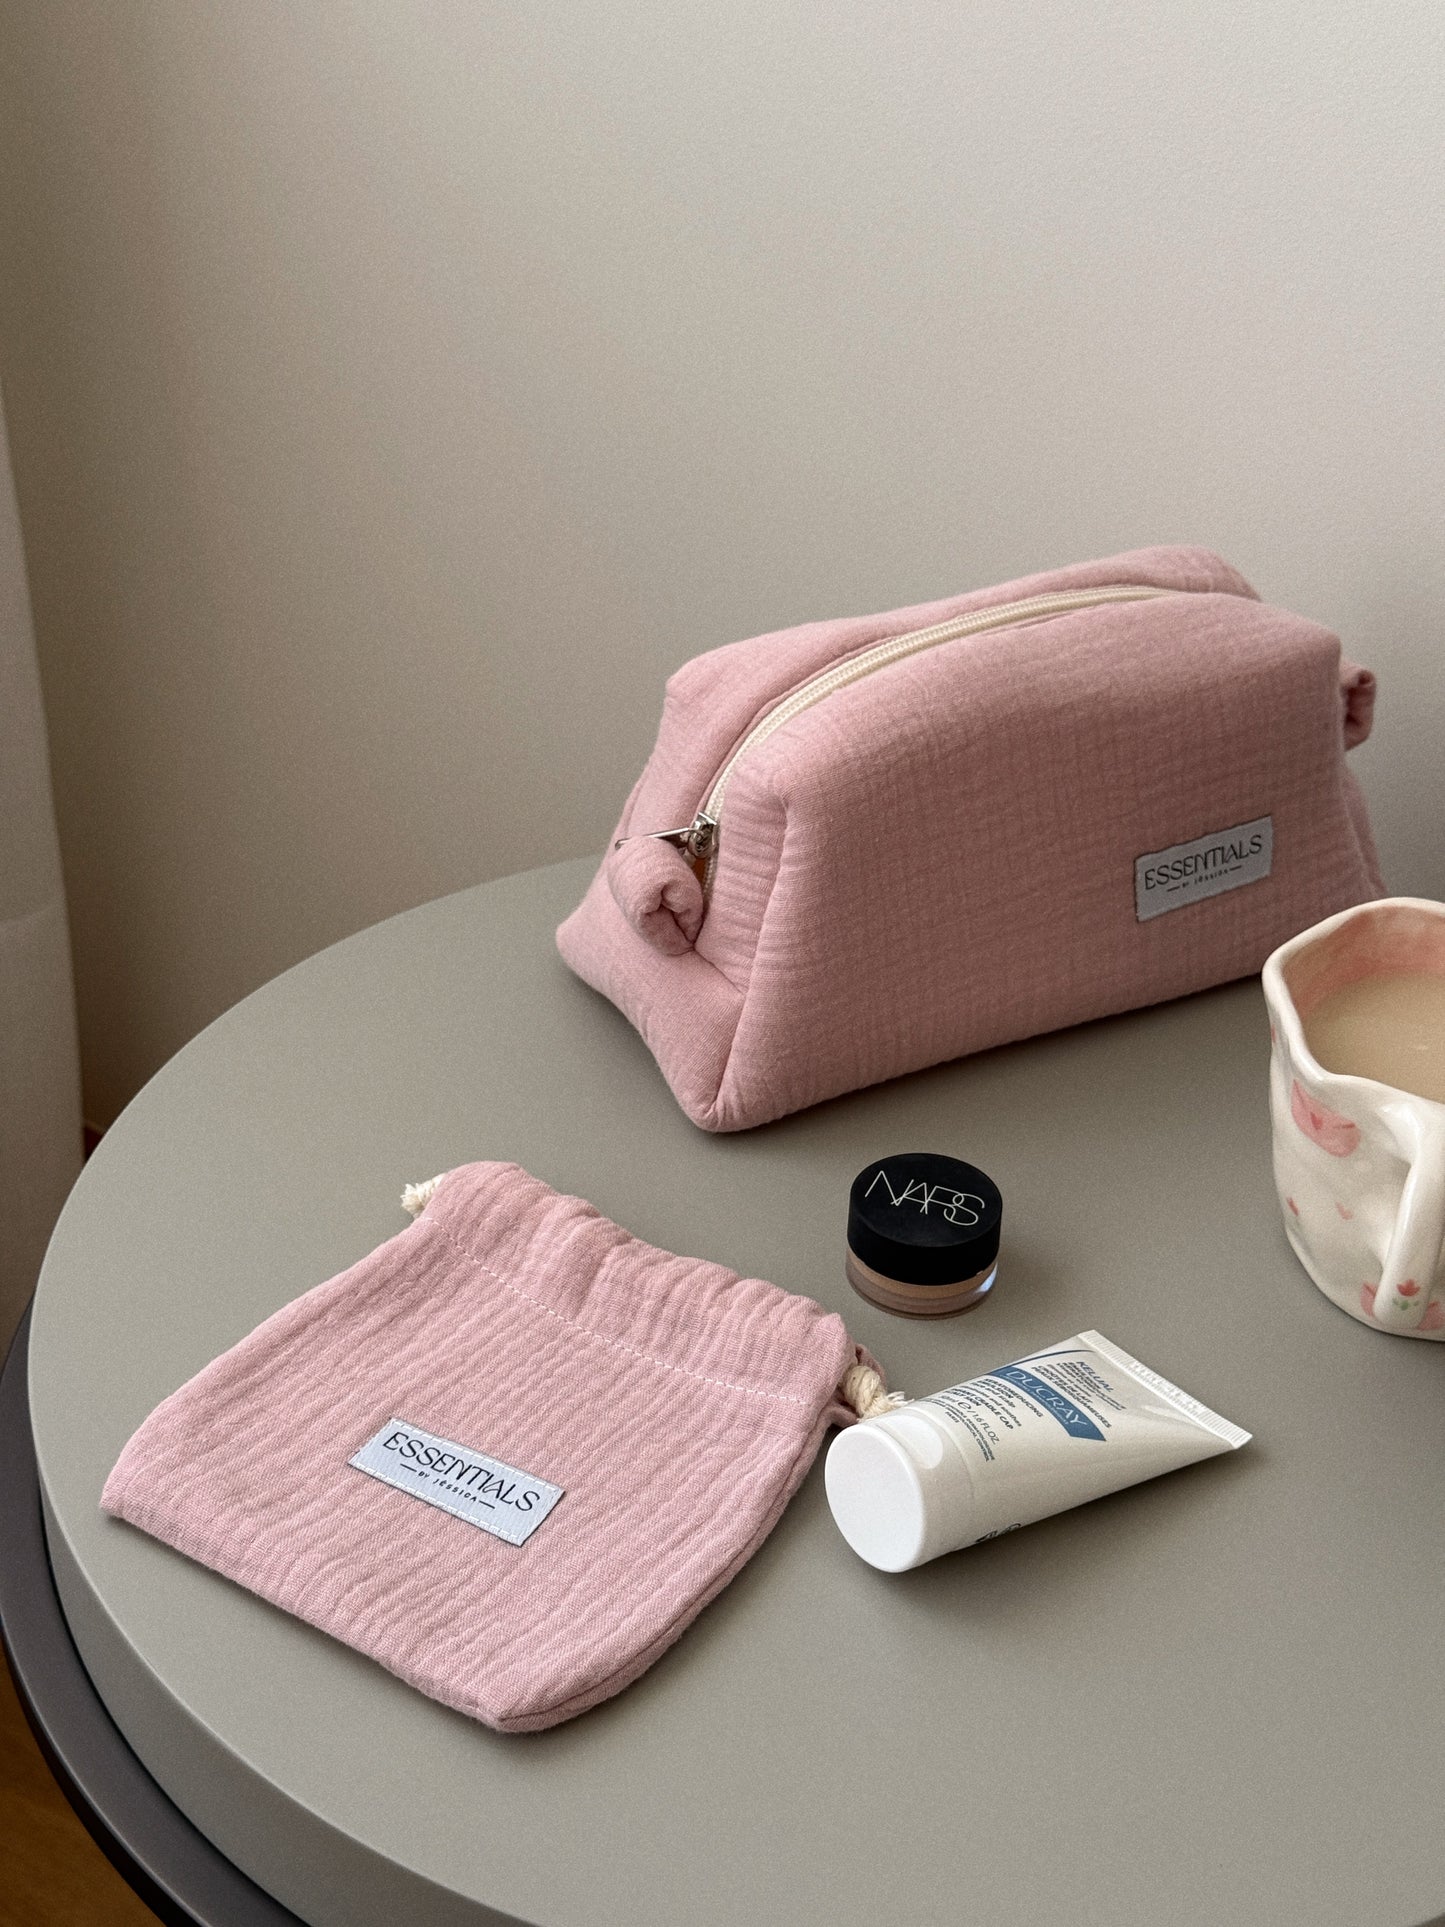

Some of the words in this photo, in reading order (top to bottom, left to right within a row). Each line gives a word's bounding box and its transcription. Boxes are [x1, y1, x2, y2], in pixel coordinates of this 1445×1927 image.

[1145, 834, 1263, 891] ESSENTIALS
[865, 1170, 985, 1226] NARS
[972, 1413, 982, 1422] 1.6
[974, 1396, 1002, 1416] CRADLE
[999, 1416, 1014, 1429] CAP
[1006, 1370, 1087, 1425] DUCRAY
[383, 1431, 540, 1511] ESSENTIALS
[417, 1470, 430, 1479] BY
